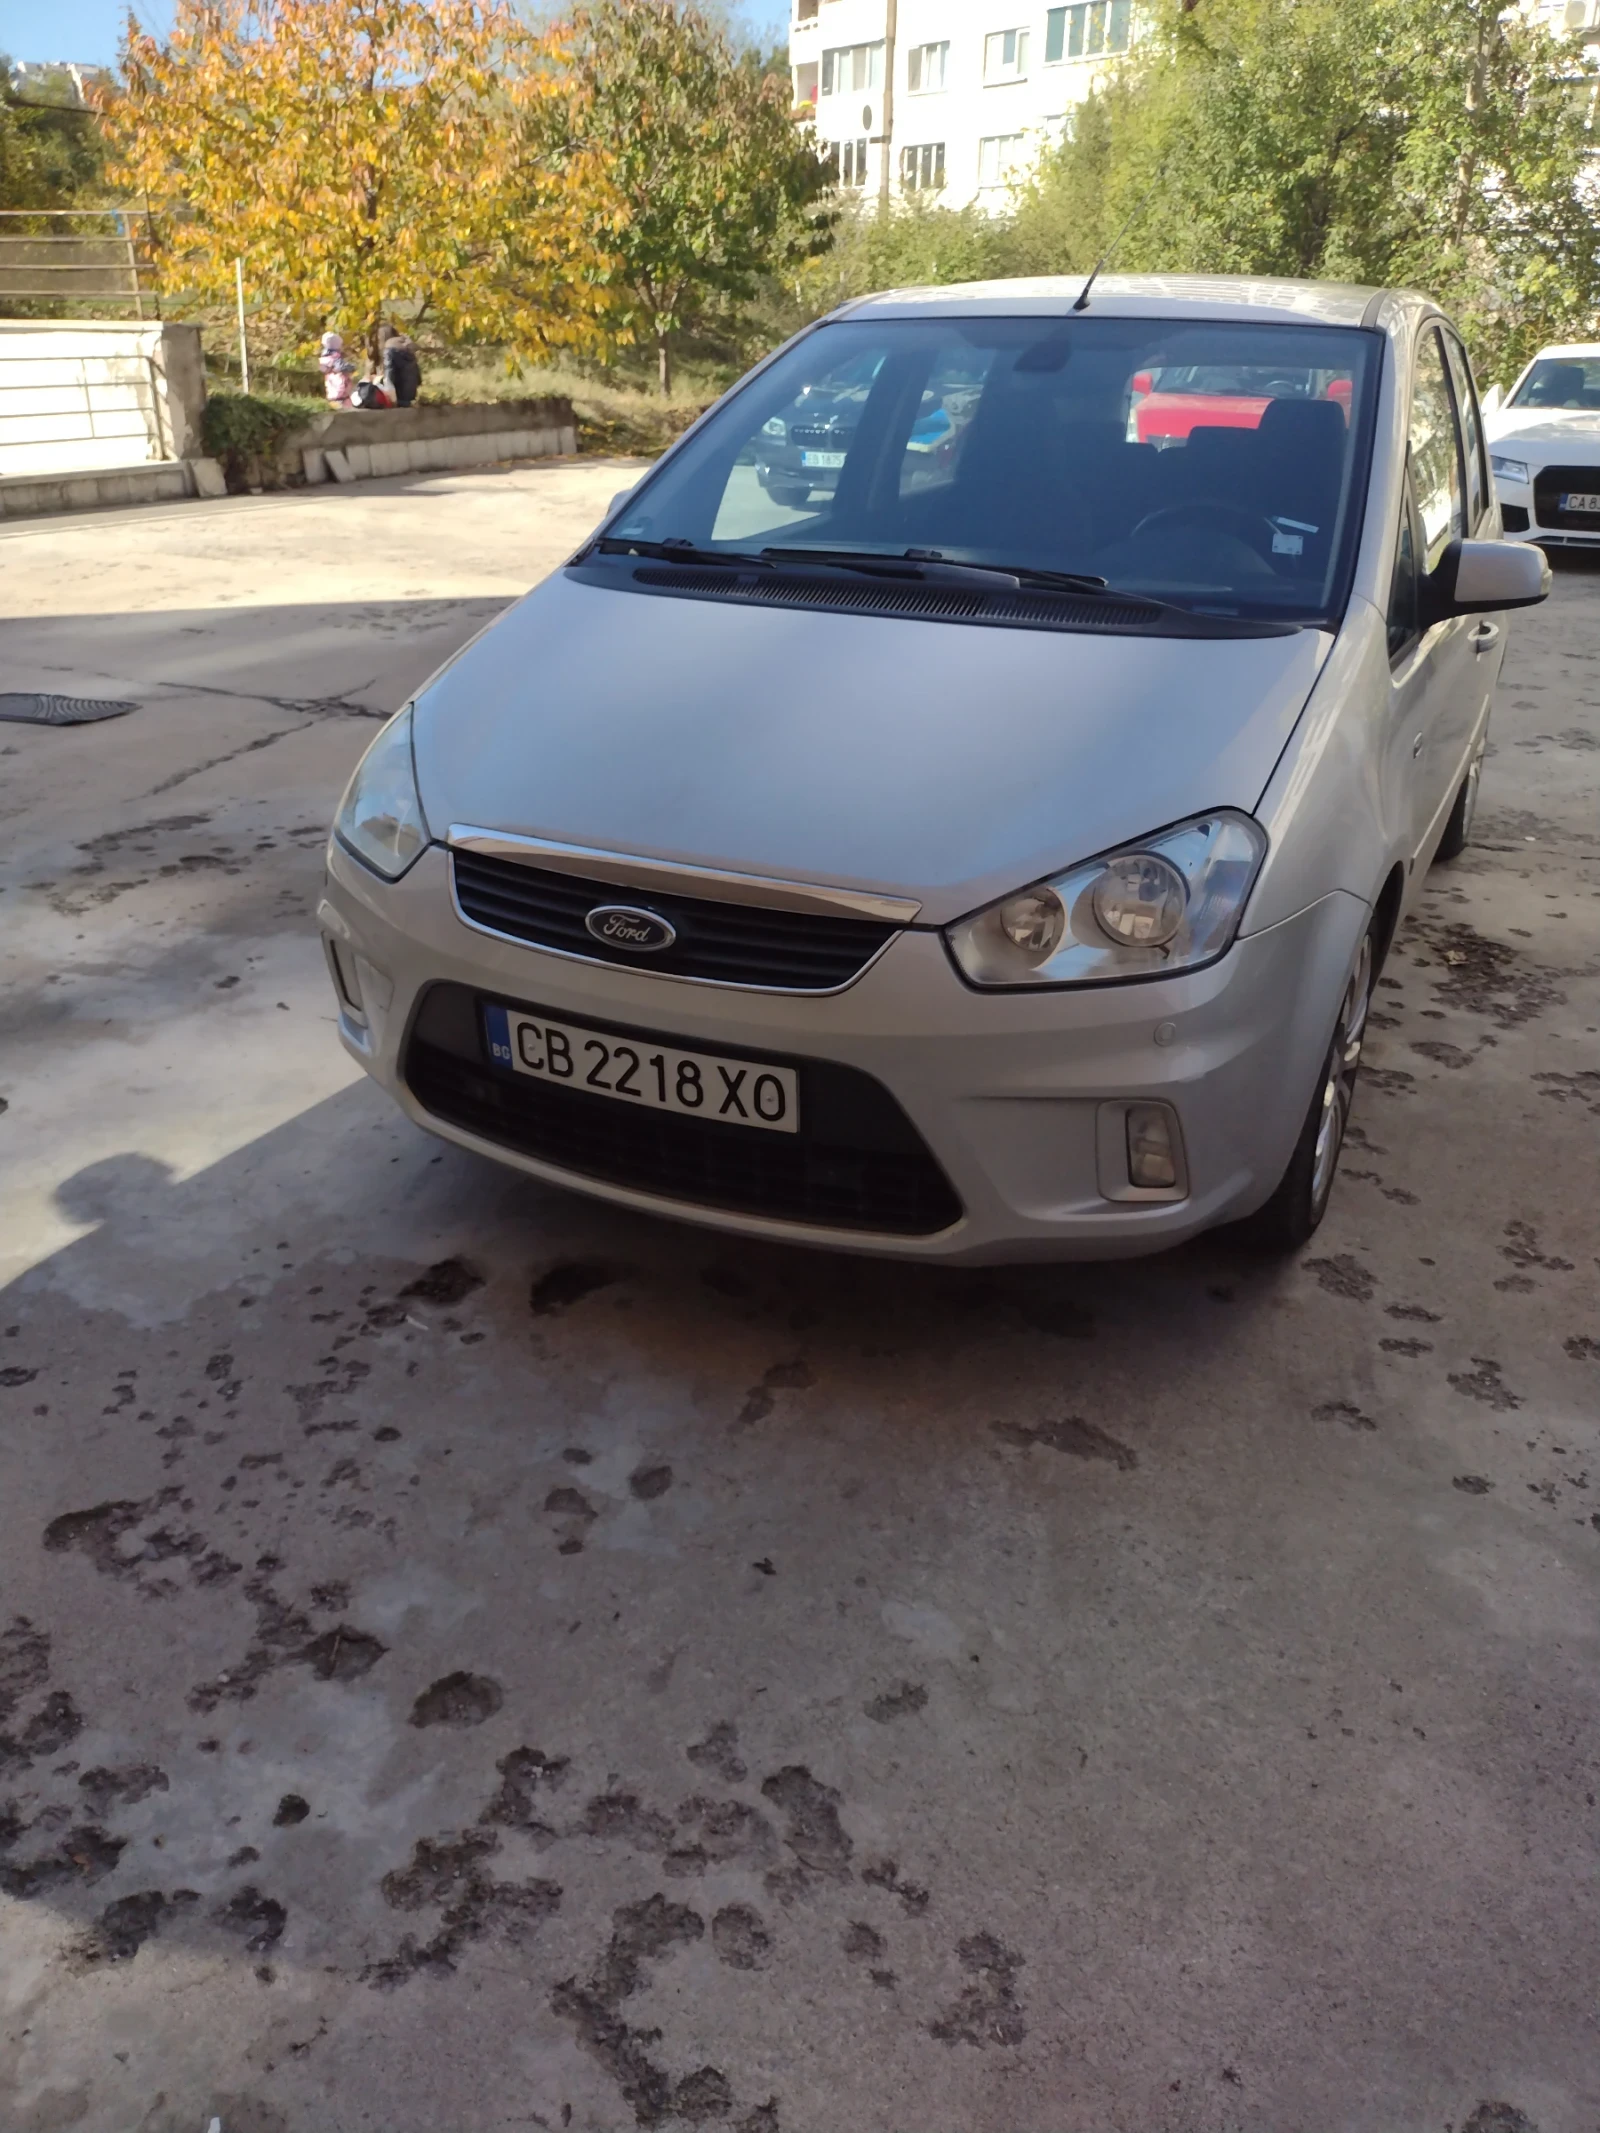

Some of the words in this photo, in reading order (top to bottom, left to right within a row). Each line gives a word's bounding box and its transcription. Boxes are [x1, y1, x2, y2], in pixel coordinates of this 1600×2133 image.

[1569, 496, 1585, 509] CA
[1588, 497, 1600, 509] 8
[603, 914, 651, 942] Ford
[493, 1043, 509, 1060] BG
[517, 1022, 573, 1078] CB
[584, 1040, 703, 1108] 2218
[717, 1066, 786, 1121] XO
